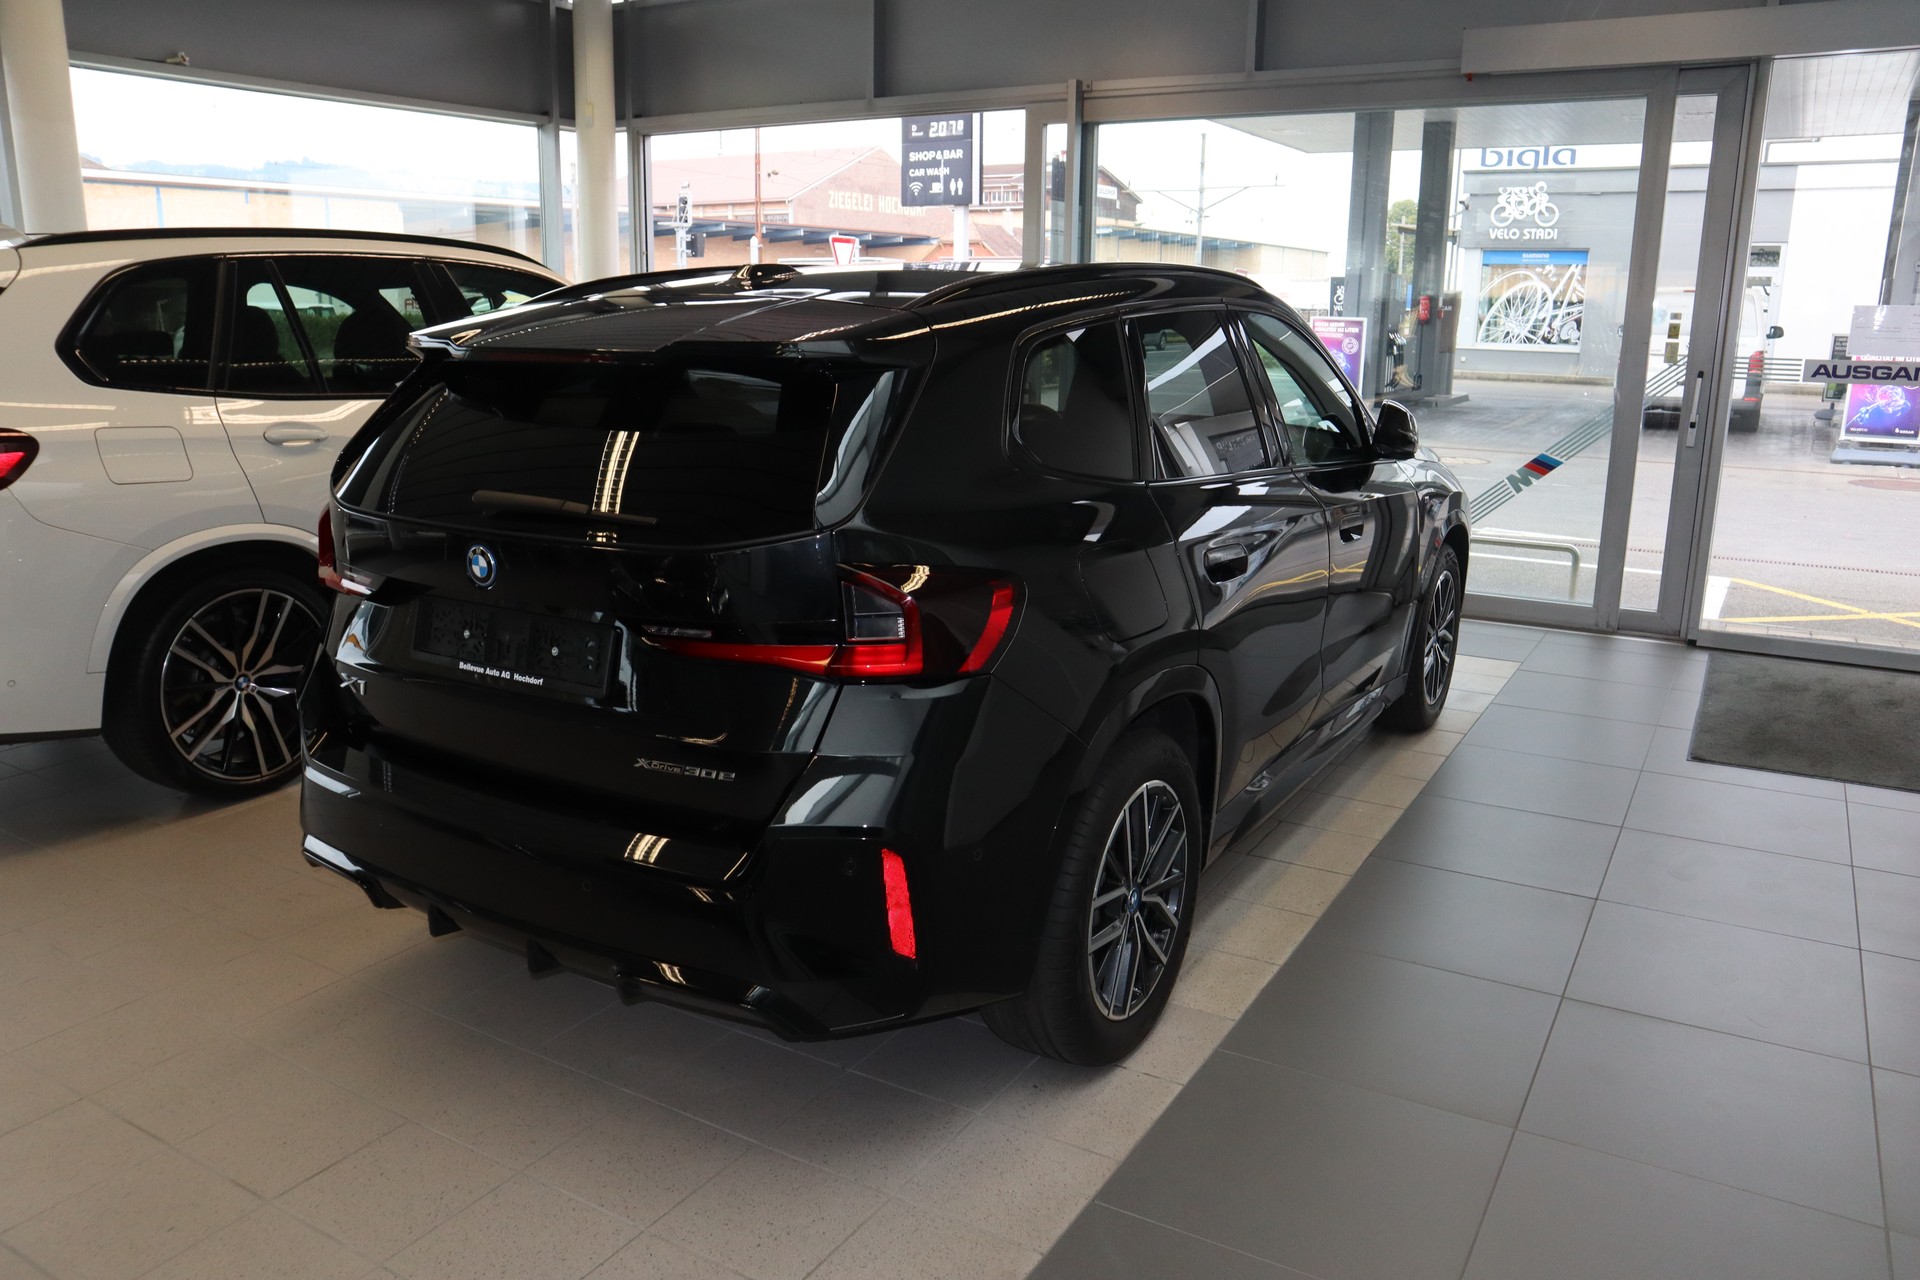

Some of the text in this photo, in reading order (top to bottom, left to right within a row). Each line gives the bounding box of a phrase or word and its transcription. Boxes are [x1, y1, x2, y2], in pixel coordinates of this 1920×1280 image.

[1480, 145, 1577, 170] bigla
[909, 167, 949, 177] CAR WASH
[829, 190, 873, 212] ZIEGELEI
[1488, 228, 1558, 240] VELO STADI
[339, 672, 366, 696] X1
[459, 661, 544, 686] Bellevue Auto AG Hochdorf
